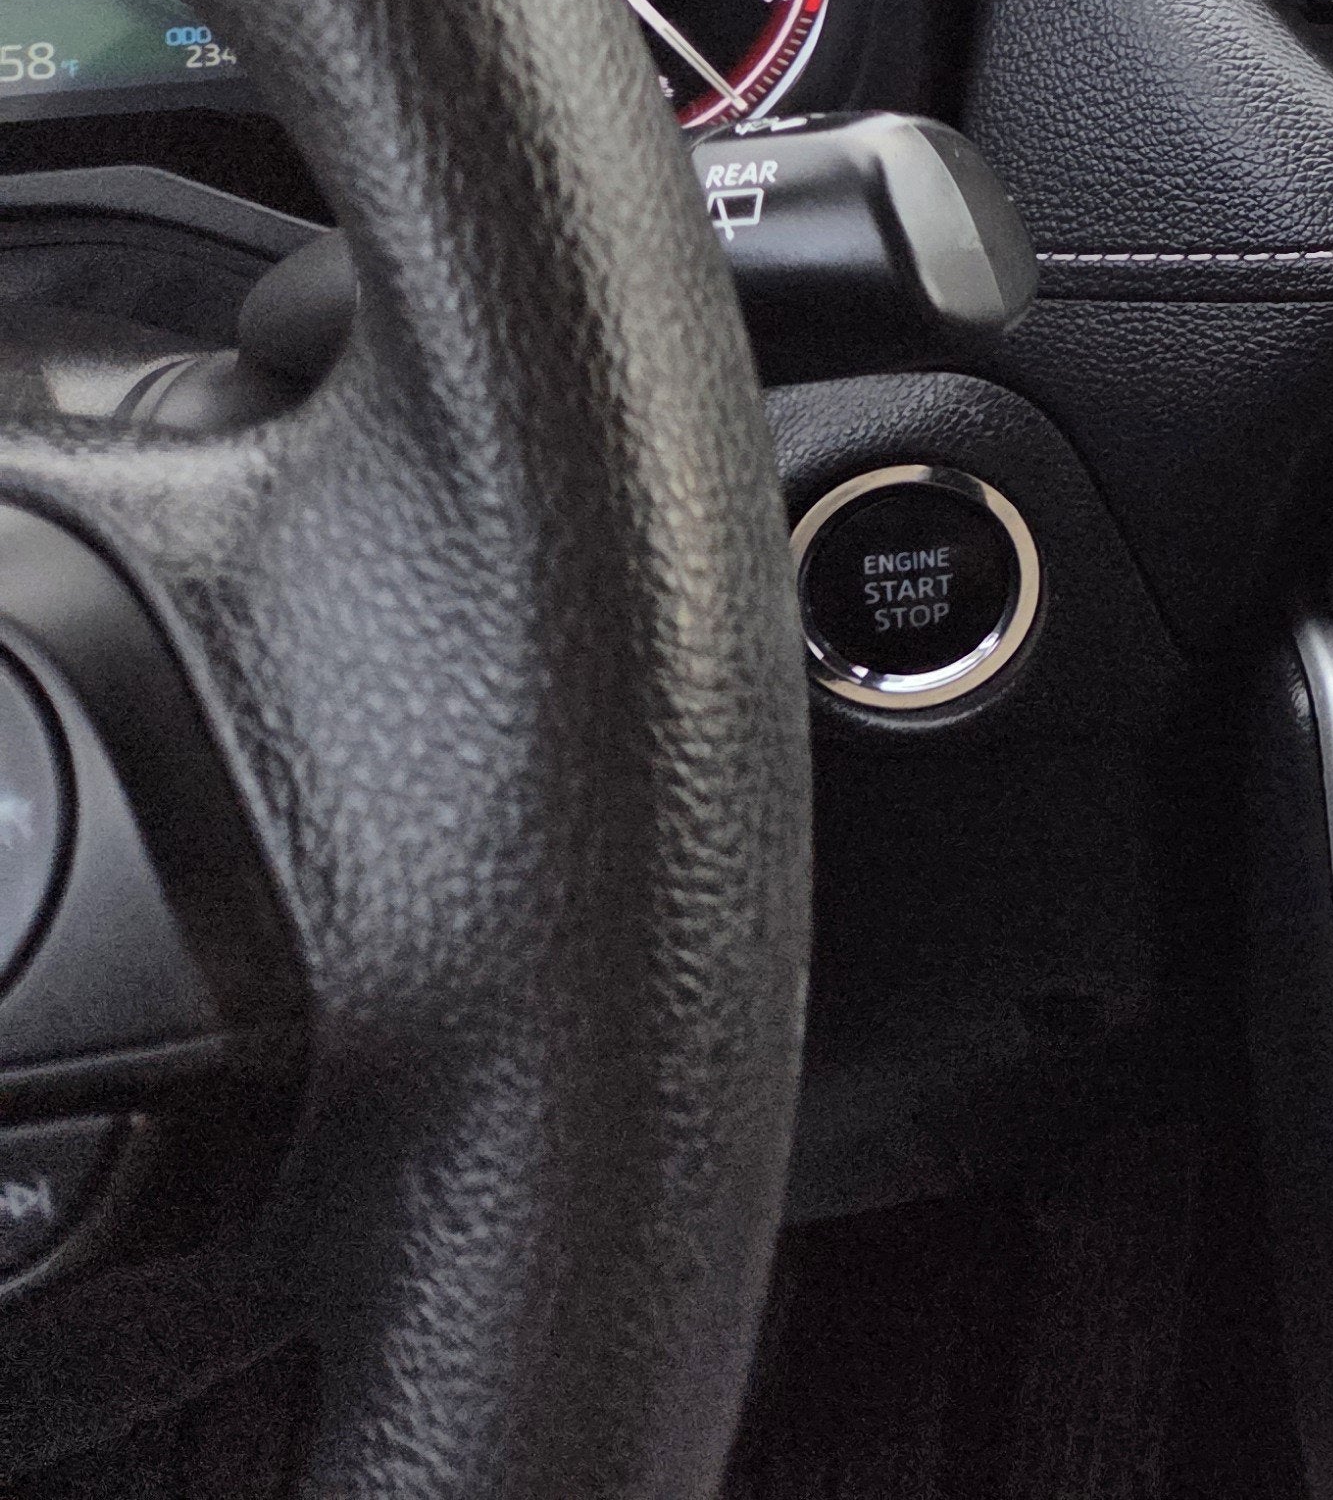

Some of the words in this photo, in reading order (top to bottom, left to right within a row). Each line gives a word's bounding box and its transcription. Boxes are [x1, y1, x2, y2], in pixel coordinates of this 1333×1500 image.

[0, 42, 56, 82] 58
[705, 160, 779, 189] REAR
[863, 547, 950, 575] ENGINE
[864, 574, 953, 605] START
[873, 602, 950, 632] STOP
